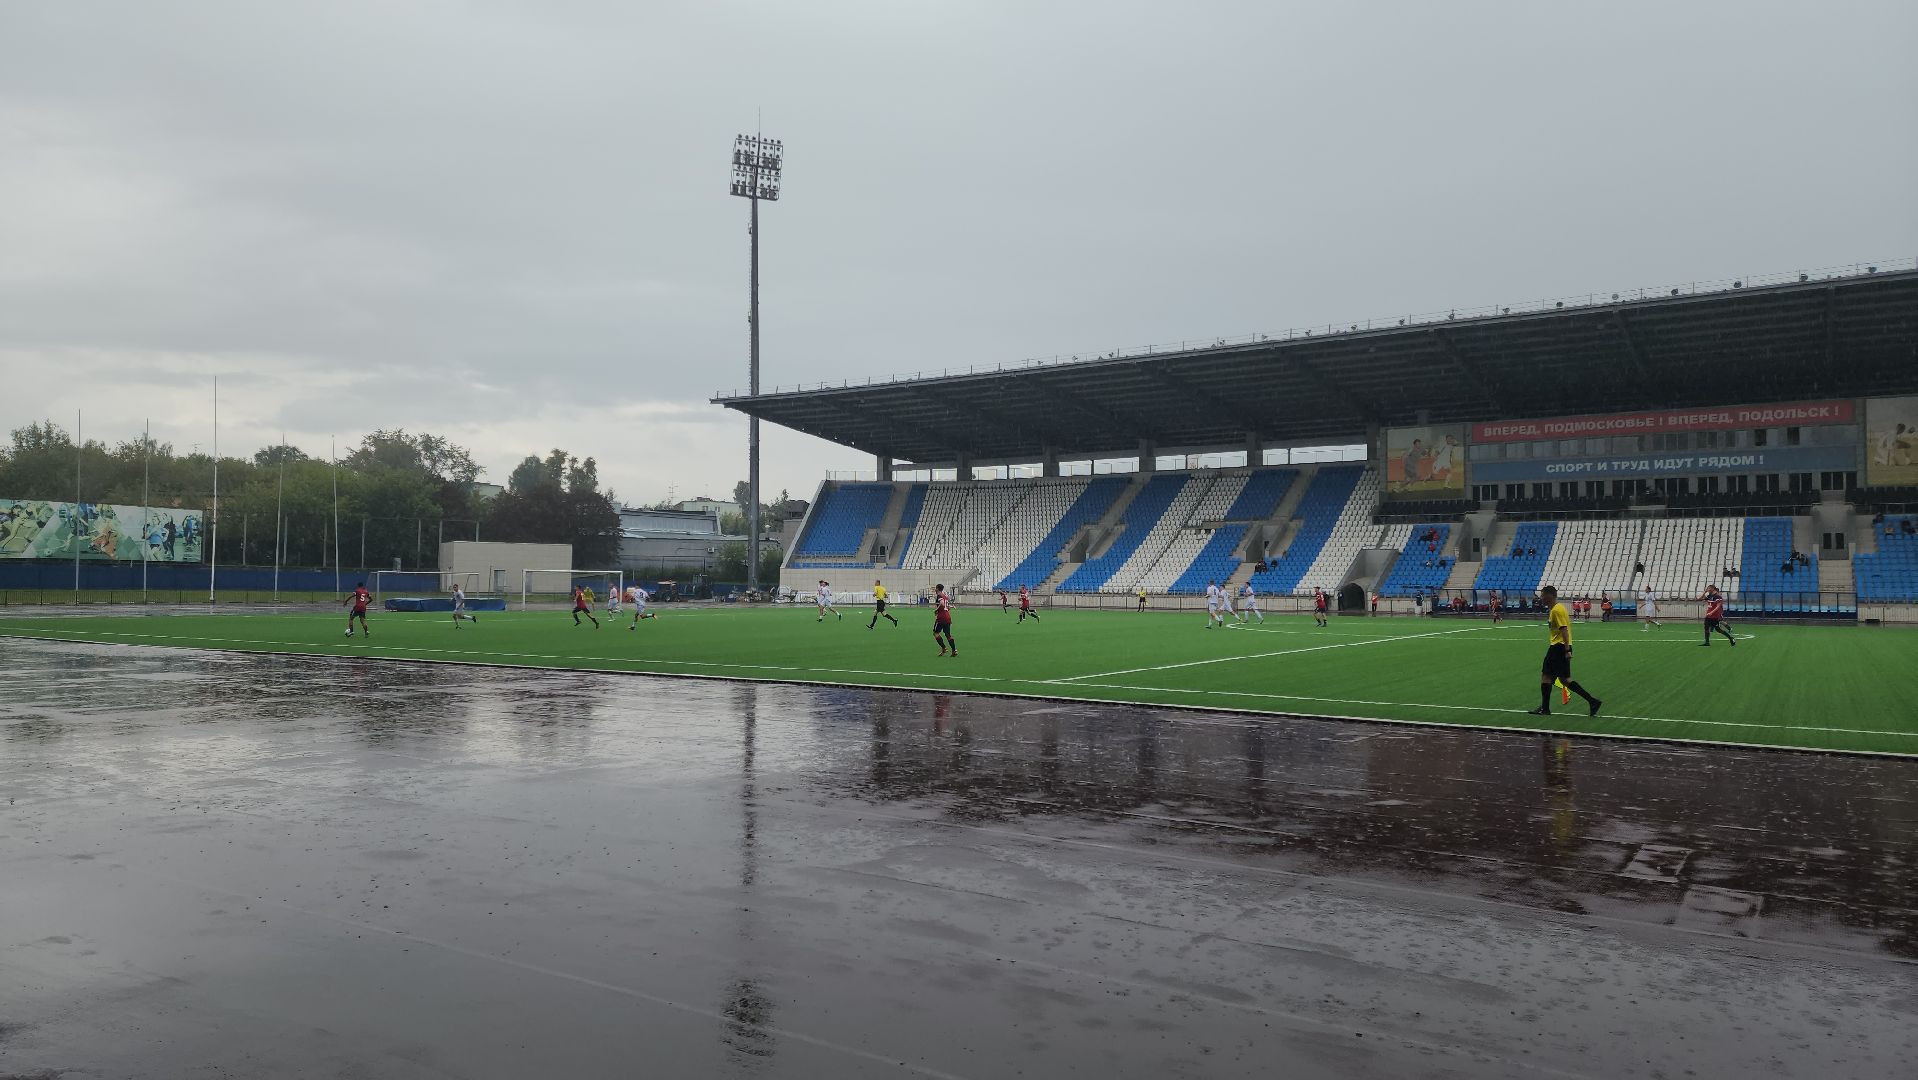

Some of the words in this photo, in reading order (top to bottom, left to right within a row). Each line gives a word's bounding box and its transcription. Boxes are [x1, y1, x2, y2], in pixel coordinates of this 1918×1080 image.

[1544, 417, 1655, 434] ПОДМОСКОВЬЕ
[1739, 407, 1829, 423] ПОДОЛЬСК
[1835, 406, 1839, 415] !
[1545, 462, 1592, 473] СПОРТ
[1597, 461, 1607, 471] И
[1612, 460, 1650, 471] ТРУД
[1654, 457, 1694, 470] ИДУТ
[1698, 455, 1755, 468] РЯДОМ
[1759, 455, 1764, 464] !
